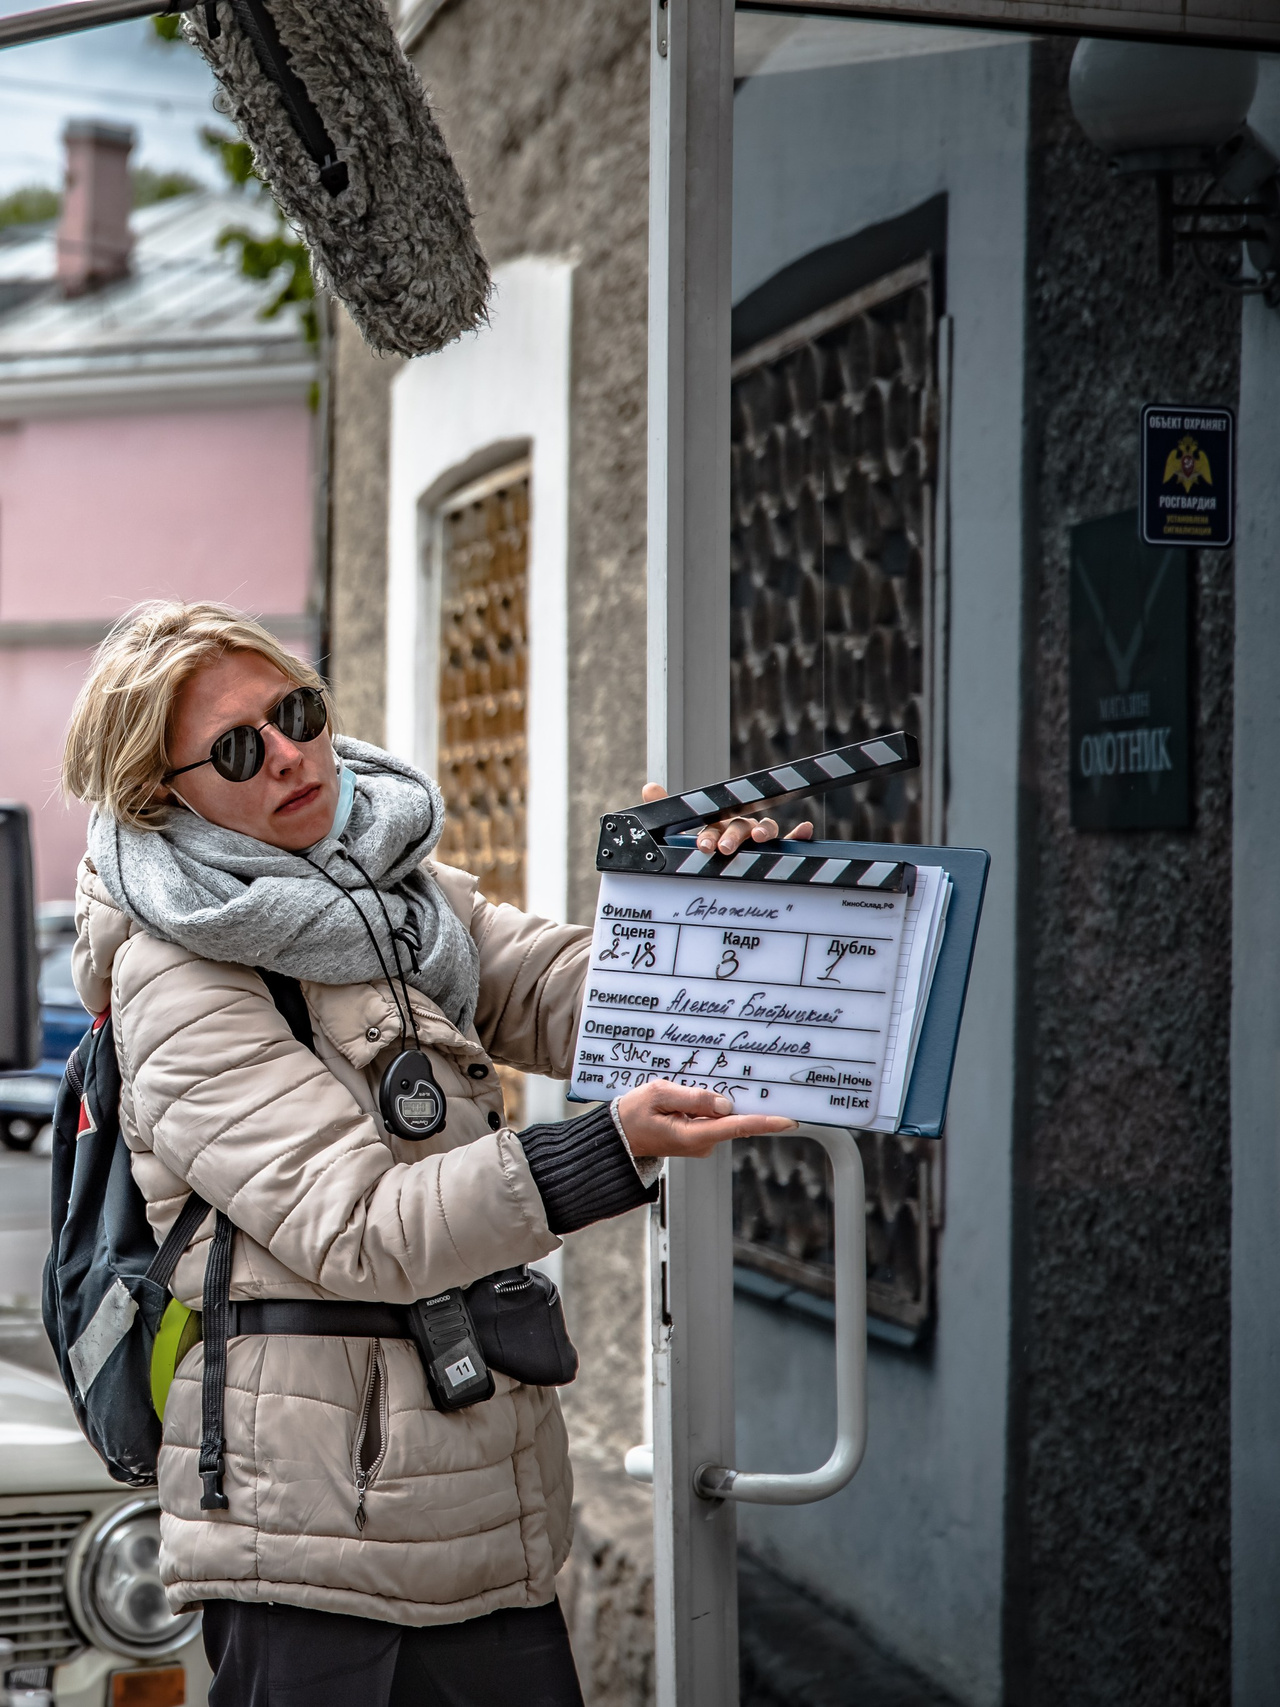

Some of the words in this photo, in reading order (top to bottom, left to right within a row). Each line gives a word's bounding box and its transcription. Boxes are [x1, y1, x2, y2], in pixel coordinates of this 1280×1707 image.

[1149, 415, 1182, 429] ОБЪЕКТ
[1184, 418, 1227, 431] ОХРАНЯЕТ
[1159, 495, 1216, 510] РОСГВАРДИЯ
[1080, 726, 1172, 777] ОХОТНИК
[602, 903, 652, 919] Фильм
[842, 899, 895, 910] КиноСклад.РФ
[612, 923, 656, 940] Сцена
[723, 932, 760, 949] Кадр
[827, 940, 876, 956] Дубль
[716, 950, 739, 979] 3
[816, 953, 842, 984] 1
[589, 989, 659, 1009] Режиссер
[584, 1020, 655, 1041] Оператор
[661, 1023, 726, 1045] Николай
[729, 1031, 811, 1054] Смирнов
[579, 1050, 604, 1063] Звук
[651, 1057, 671, 1068] FPS
[577, 1071, 604, 1083] Дата
[760, 1088, 769, 1098] D
[426, 1295, 451, 1306] KENWOOD
[455, 1362, 470, 1376] 11
